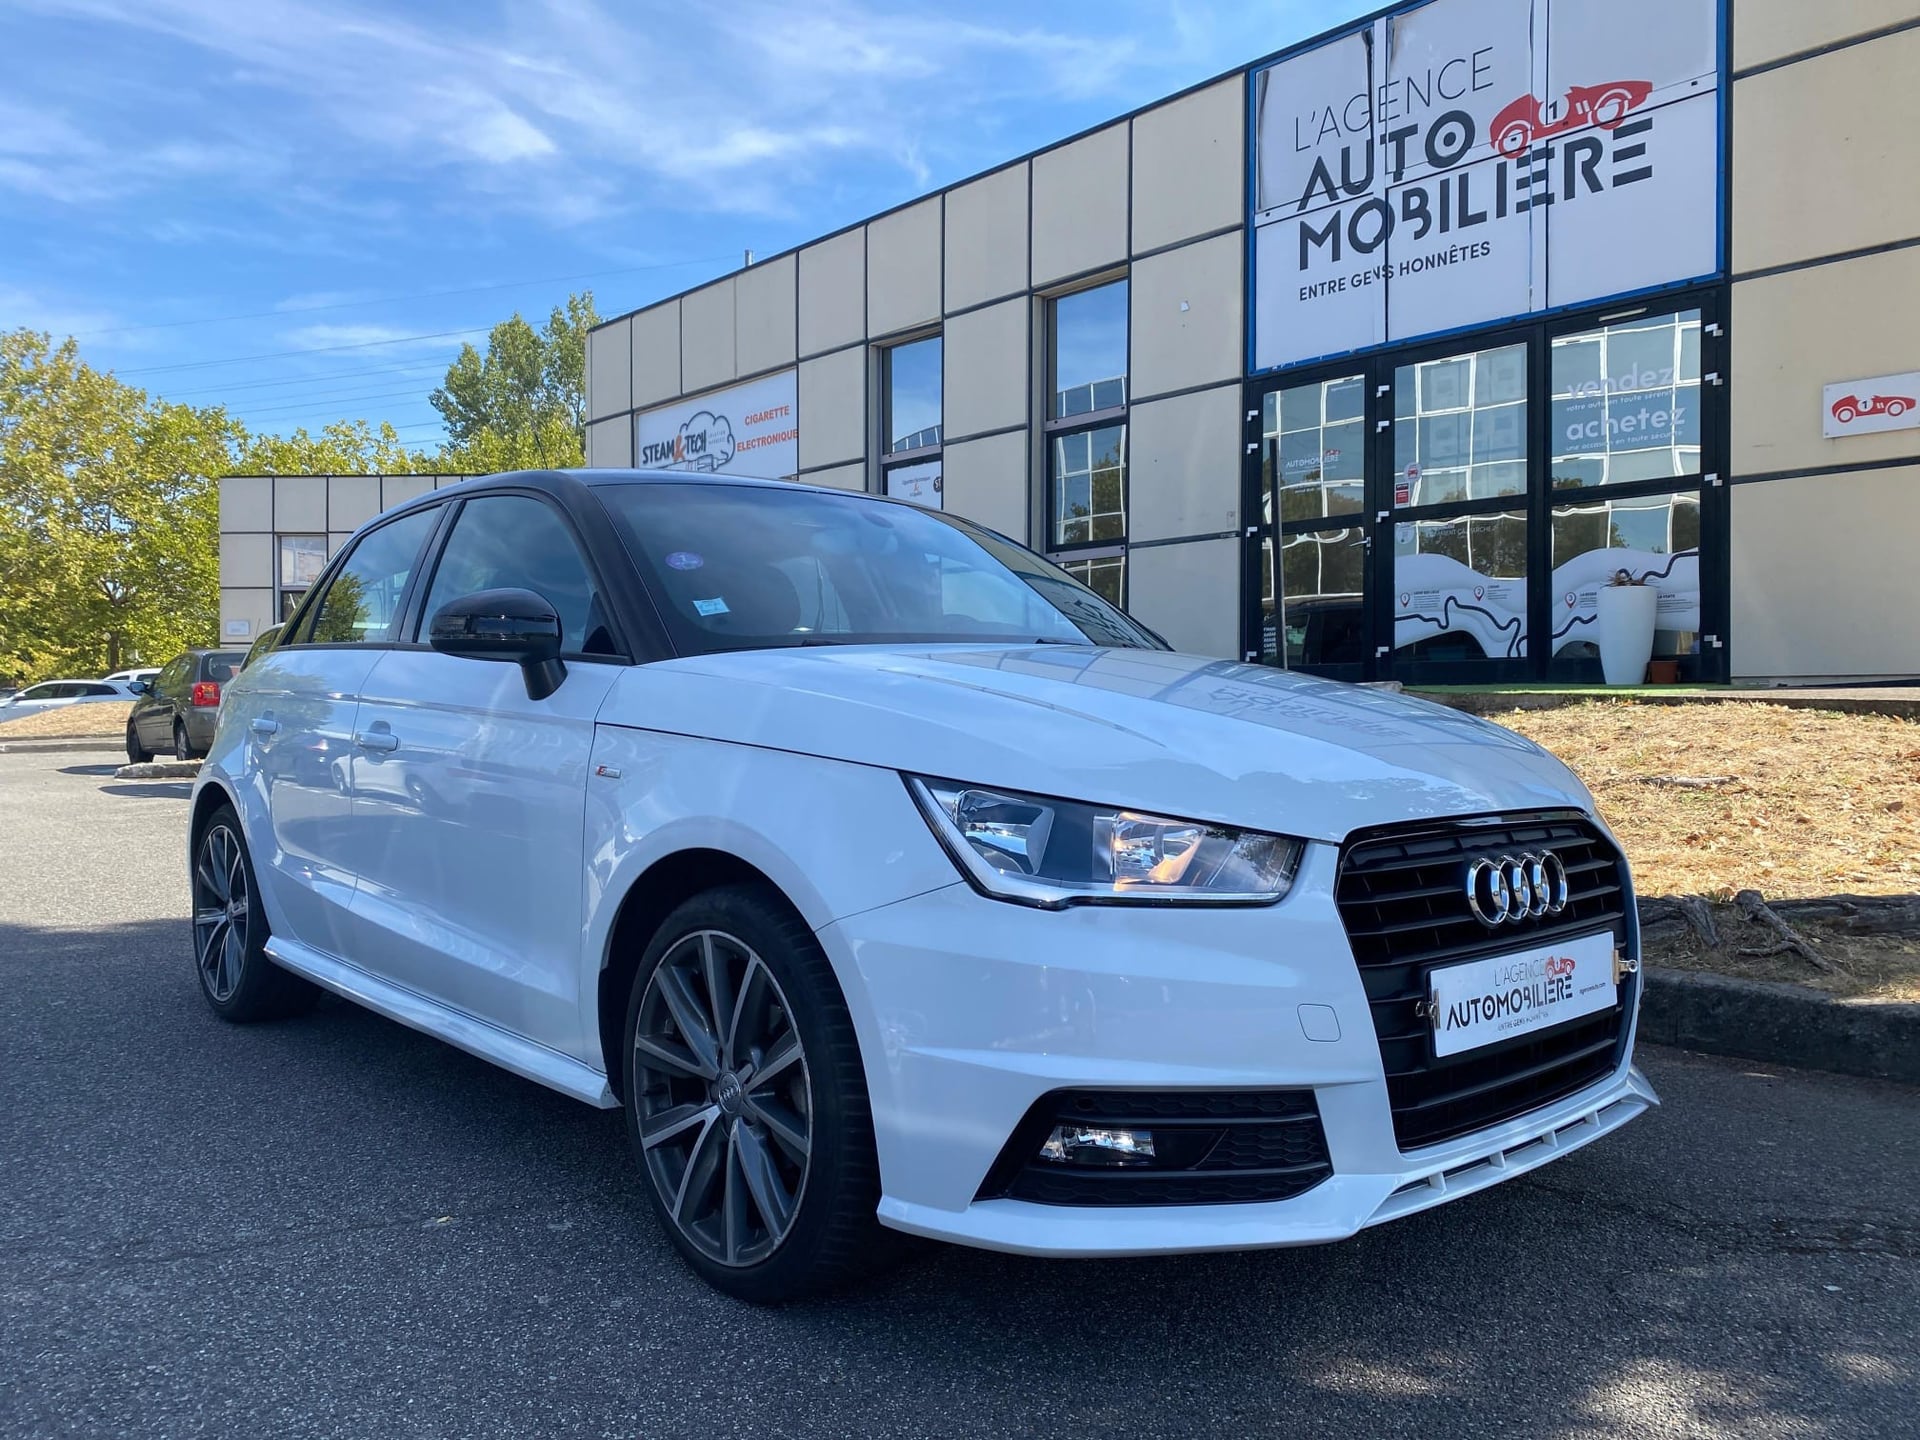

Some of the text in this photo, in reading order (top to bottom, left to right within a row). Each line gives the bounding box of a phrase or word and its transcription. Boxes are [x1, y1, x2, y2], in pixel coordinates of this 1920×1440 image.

[1297, 109, 1476, 212] AUTO
[1299, 240, 1491, 301] ENTRE GENS HONNÊTES
[1567, 361, 1675, 399] vendez
[744, 405, 790, 426] CIGARETTE
[1862, 400, 1868, 409] 1
[736, 428, 799, 452] ELECTRONIQUE
[1566, 407, 1686, 440] achetez
[1494, 958, 1546, 987] L'AGENCE
[1446, 975, 1573, 1031] AUTOMOBILIERE
